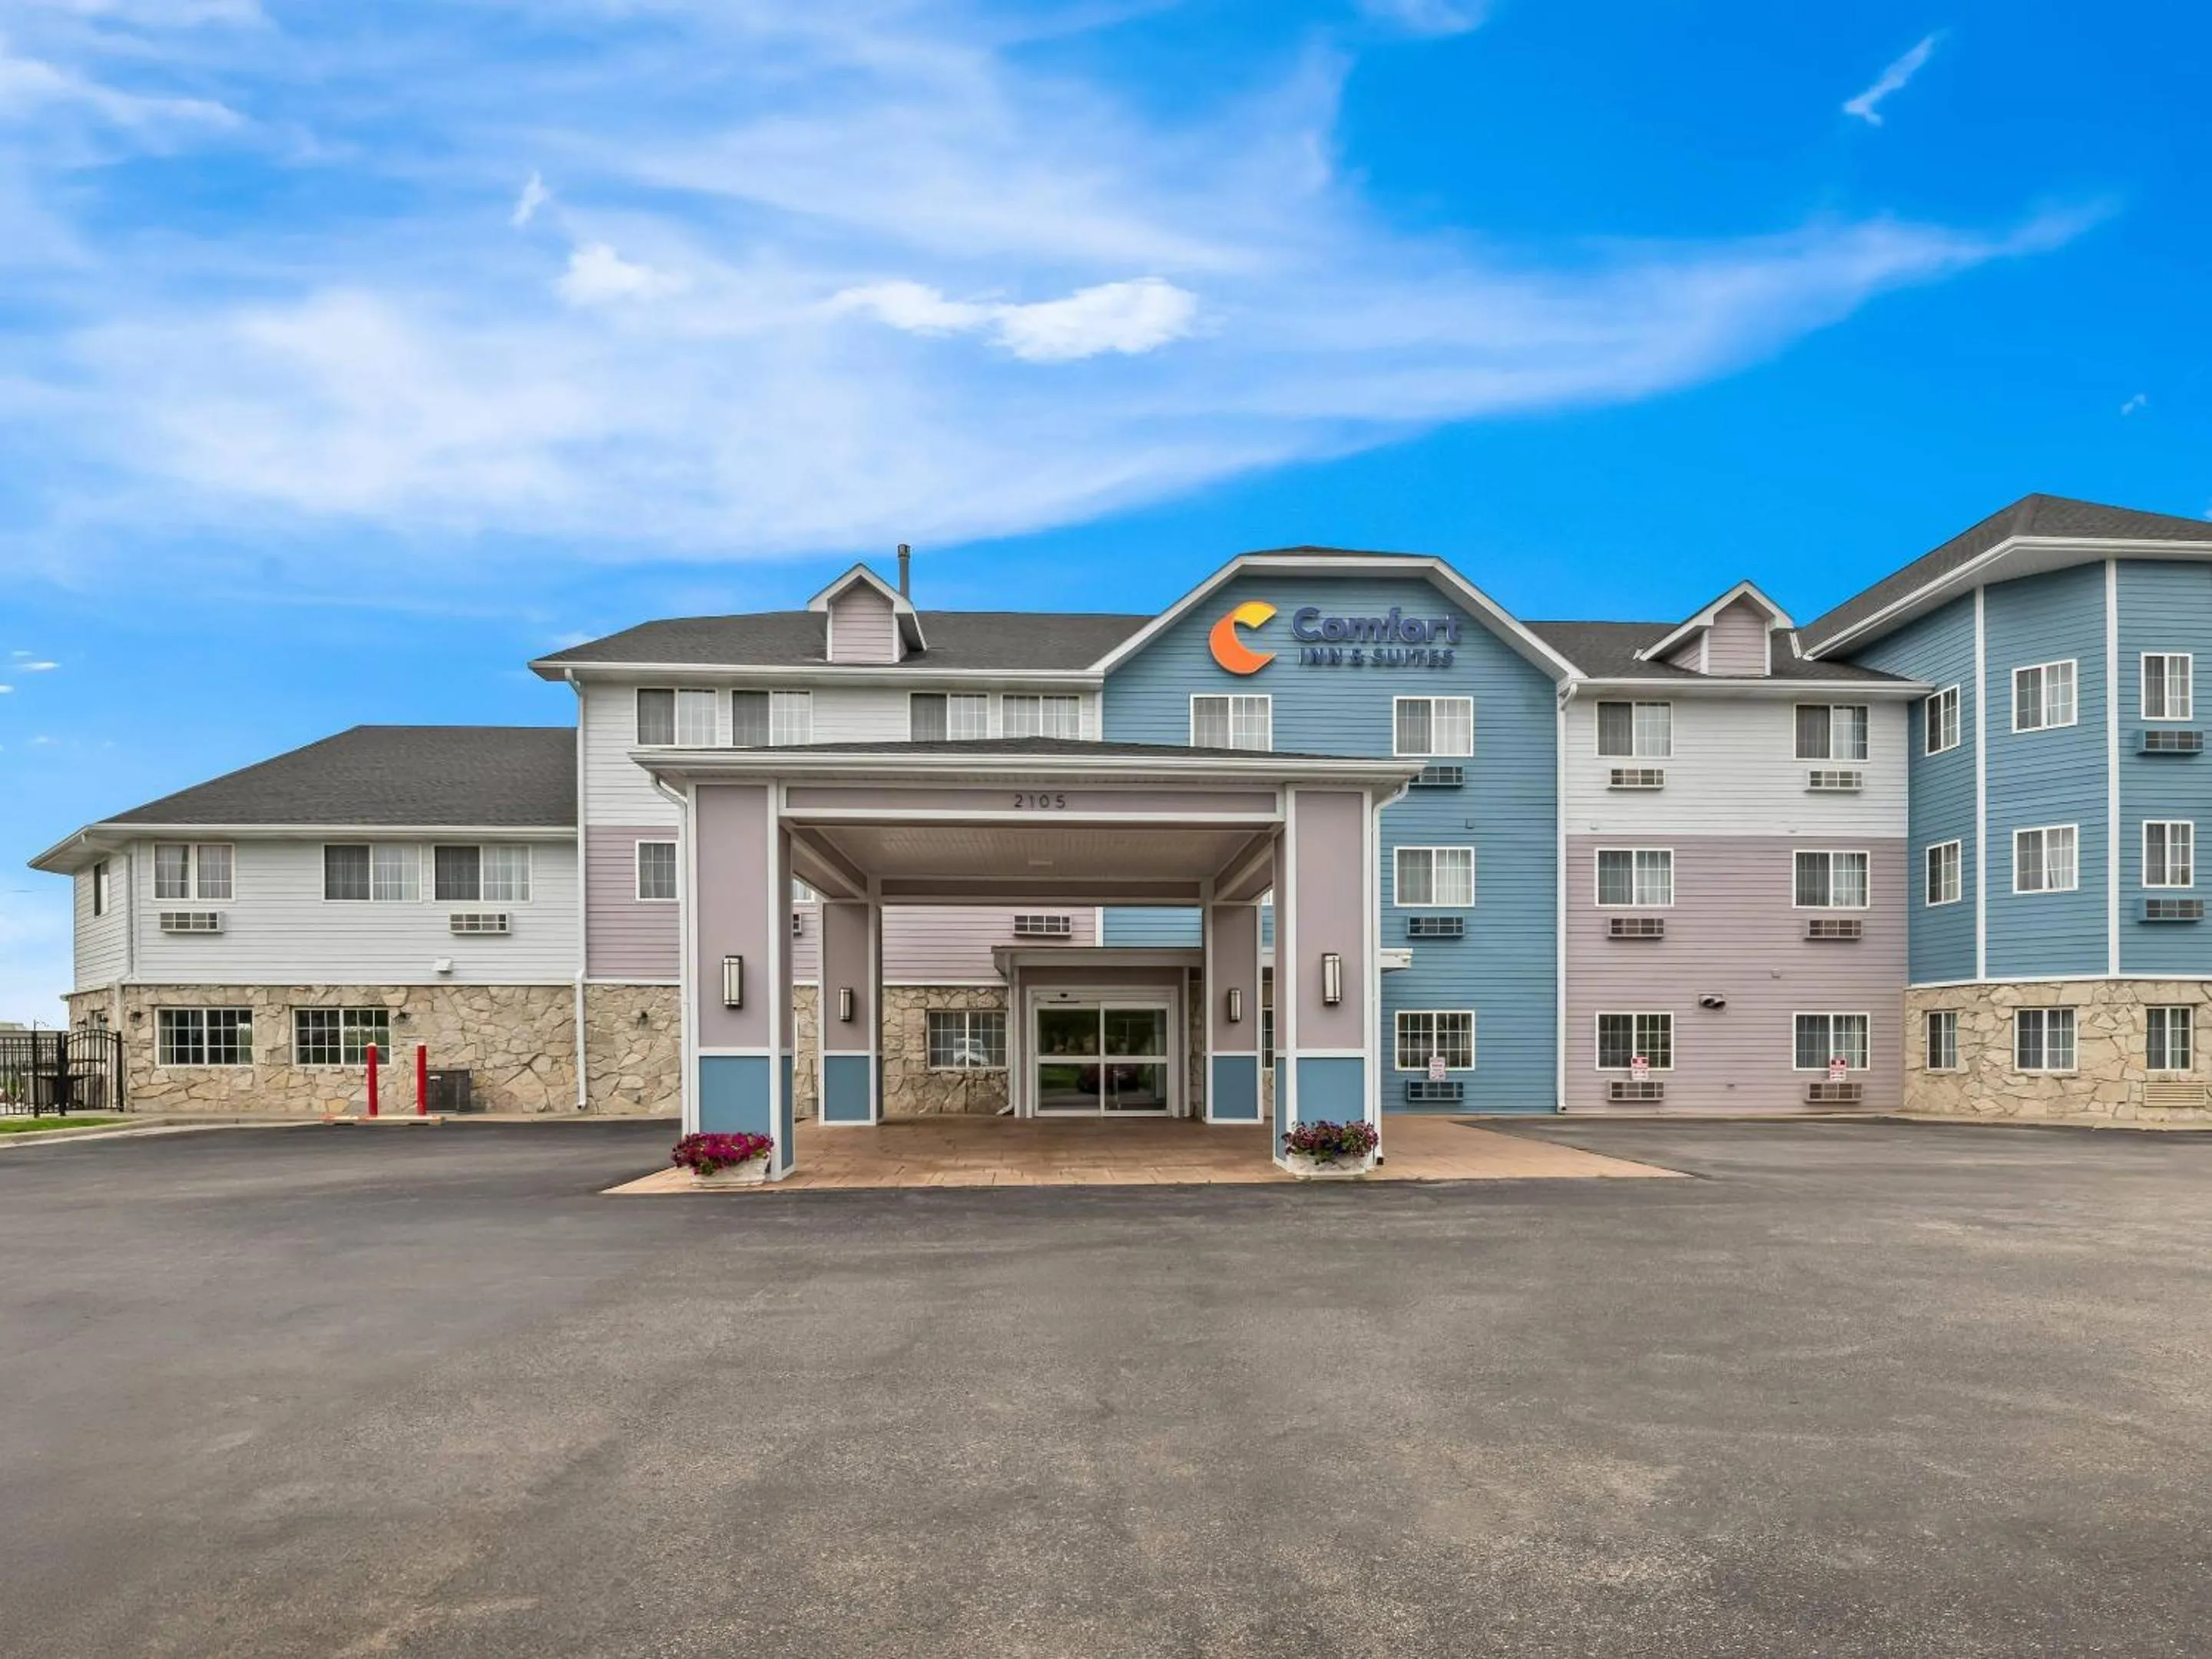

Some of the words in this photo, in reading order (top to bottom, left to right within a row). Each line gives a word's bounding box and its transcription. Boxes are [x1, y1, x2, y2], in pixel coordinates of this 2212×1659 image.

[1292, 606, 1461, 644] Comfort
[1298, 647, 1343, 666] INN
[1371, 647, 1455, 668] SUITES
[1014, 793, 1066, 810] 2105
